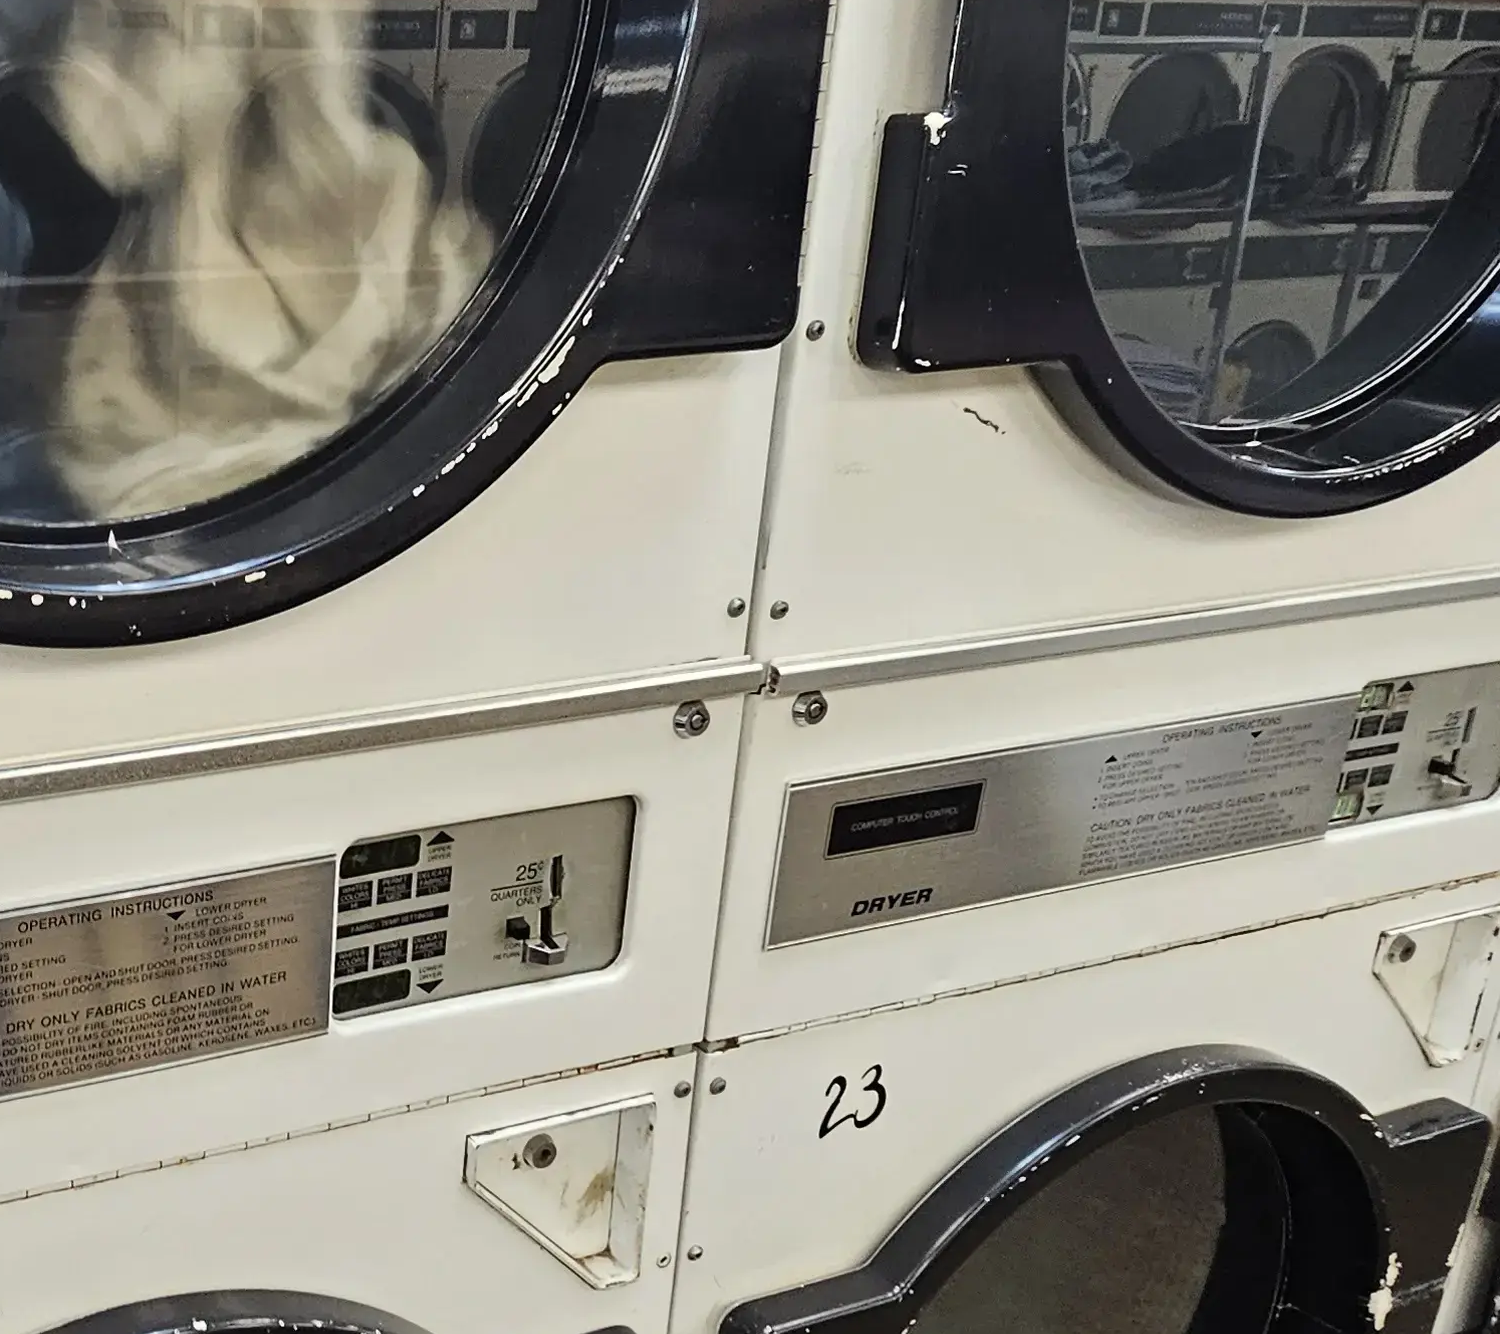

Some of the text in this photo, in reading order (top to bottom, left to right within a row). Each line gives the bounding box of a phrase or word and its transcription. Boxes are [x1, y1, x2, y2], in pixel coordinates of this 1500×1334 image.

[849, 805, 959, 832] COMPUTER TOUCH CONTROL
[195, 895, 267, 916] LOWER DRYER
[490, 885, 543, 902] QUARTERS
[516, 895, 543, 907] ONLY
[850, 886, 934, 917] DRYER
[17, 889, 213, 934] OPERATING INSTRUCTIONS
[174, 911, 244, 932] INSERT COINS
[173, 912, 294, 943] PRESS DESIRED SETTING
[21, 953, 65, 970] SETTING
[5, 1017, 34, 1034] DRY
[40, 1008, 79, 1028] ONLY
[85, 996, 146, 1019] FABRICS
[151, 983, 215, 1007] CLEANED
[221, 979, 234, 994] IN
[239, 969, 286, 990] WATER
[819, 1064, 887, 1139] 23
